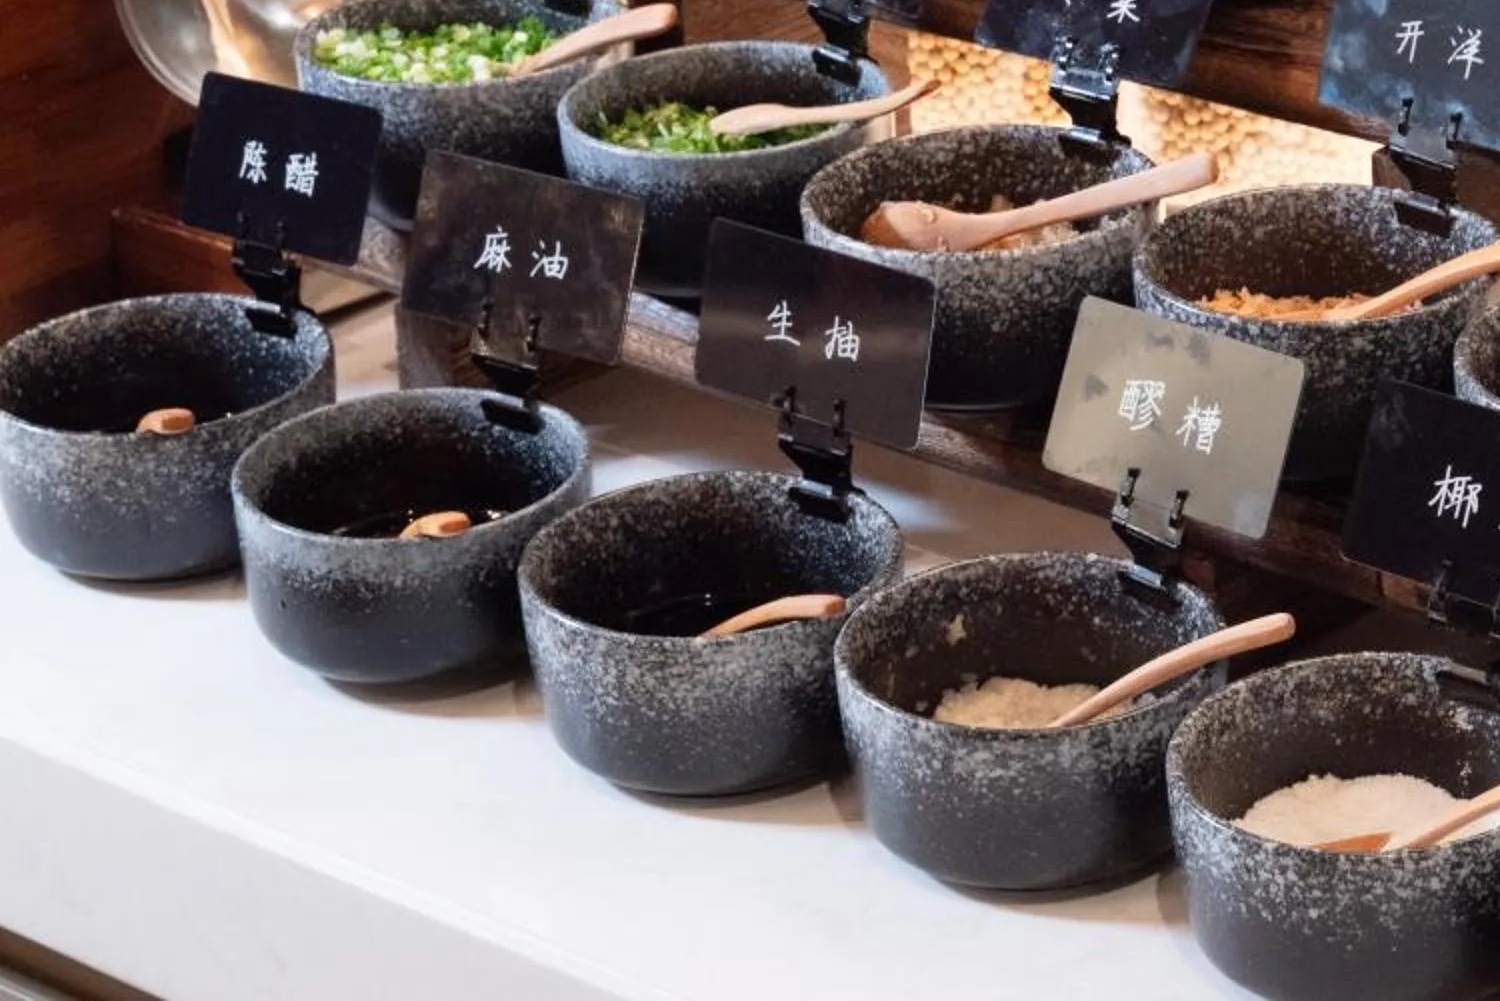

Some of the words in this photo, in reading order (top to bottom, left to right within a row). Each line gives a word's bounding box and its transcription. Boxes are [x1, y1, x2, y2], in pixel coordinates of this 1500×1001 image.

[1394, 19, 1486, 81] 开洋
[238, 139, 320, 198] 陈醋
[472, 225, 570, 281] 麻油
[763, 299, 861, 363] 生抽
[1116, 378, 1222, 455] 醪糟
